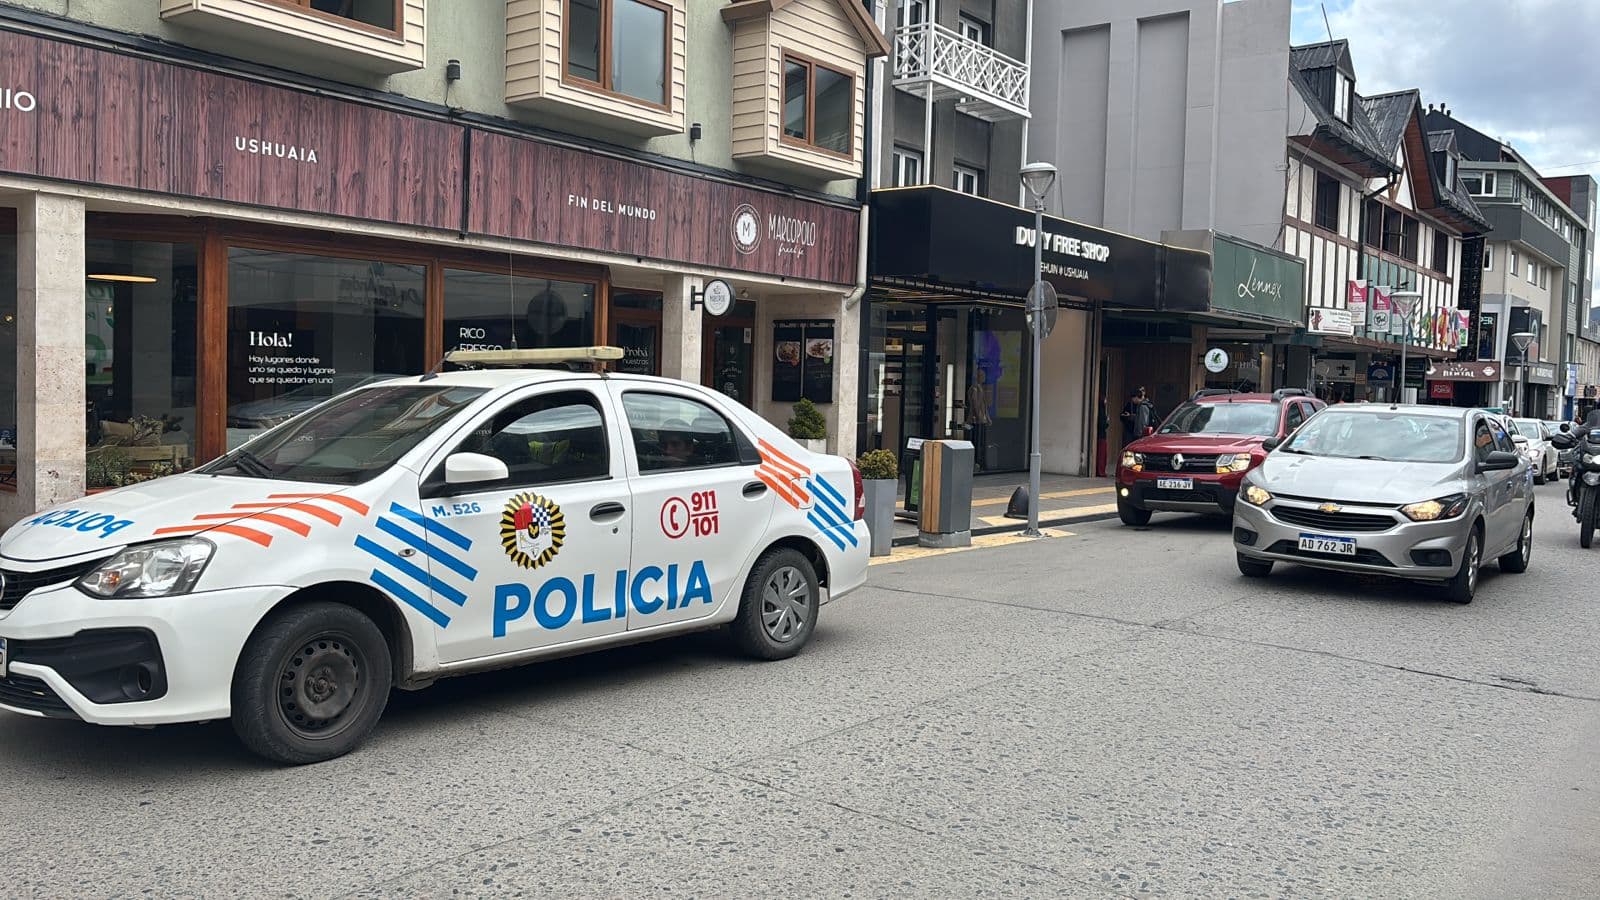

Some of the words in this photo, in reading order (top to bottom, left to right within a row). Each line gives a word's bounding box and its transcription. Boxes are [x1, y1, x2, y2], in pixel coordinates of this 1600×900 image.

[235, 136, 317, 163] USHUAIA
[568, 195, 588, 208] FIN
[593, 199, 614, 213] DEL
[618, 204, 656, 220] MUNDO
[768, 213, 816, 246] MARCOPOLO
[1015, 226, 1052, 250] DUY
[1053, 234, 1081, 257] FREE
[1081, 241, 1110, 262] SHOP
[1064, 266, 1089, 280] USHUAIA
[1237, 257, 1282, 302] Lennox
[249, 331, 292, 347] Hola!
[460, 327, 486, 339] RICO
[249, 355, 264, 364] Hay
[265, 356, 294, 365] lugares
[295, 356, 320, 364] donde
[276, 376, 306, 384] quedan
[303, 367, 308, 375] y
[308, 367, 336, 376] lugares
[432, 505, 451, 517] M.
[453, 502, 481, 515] 526
[691, 490, 718, 511] 911
[692, 515, 719, 537] 101
[1301, 538, 1314, 549] AD
[1317, 541, 1337, 552] 762
[1340, 543, 1353, 553] JR
[493, 560, 713, 638] POLICIA
